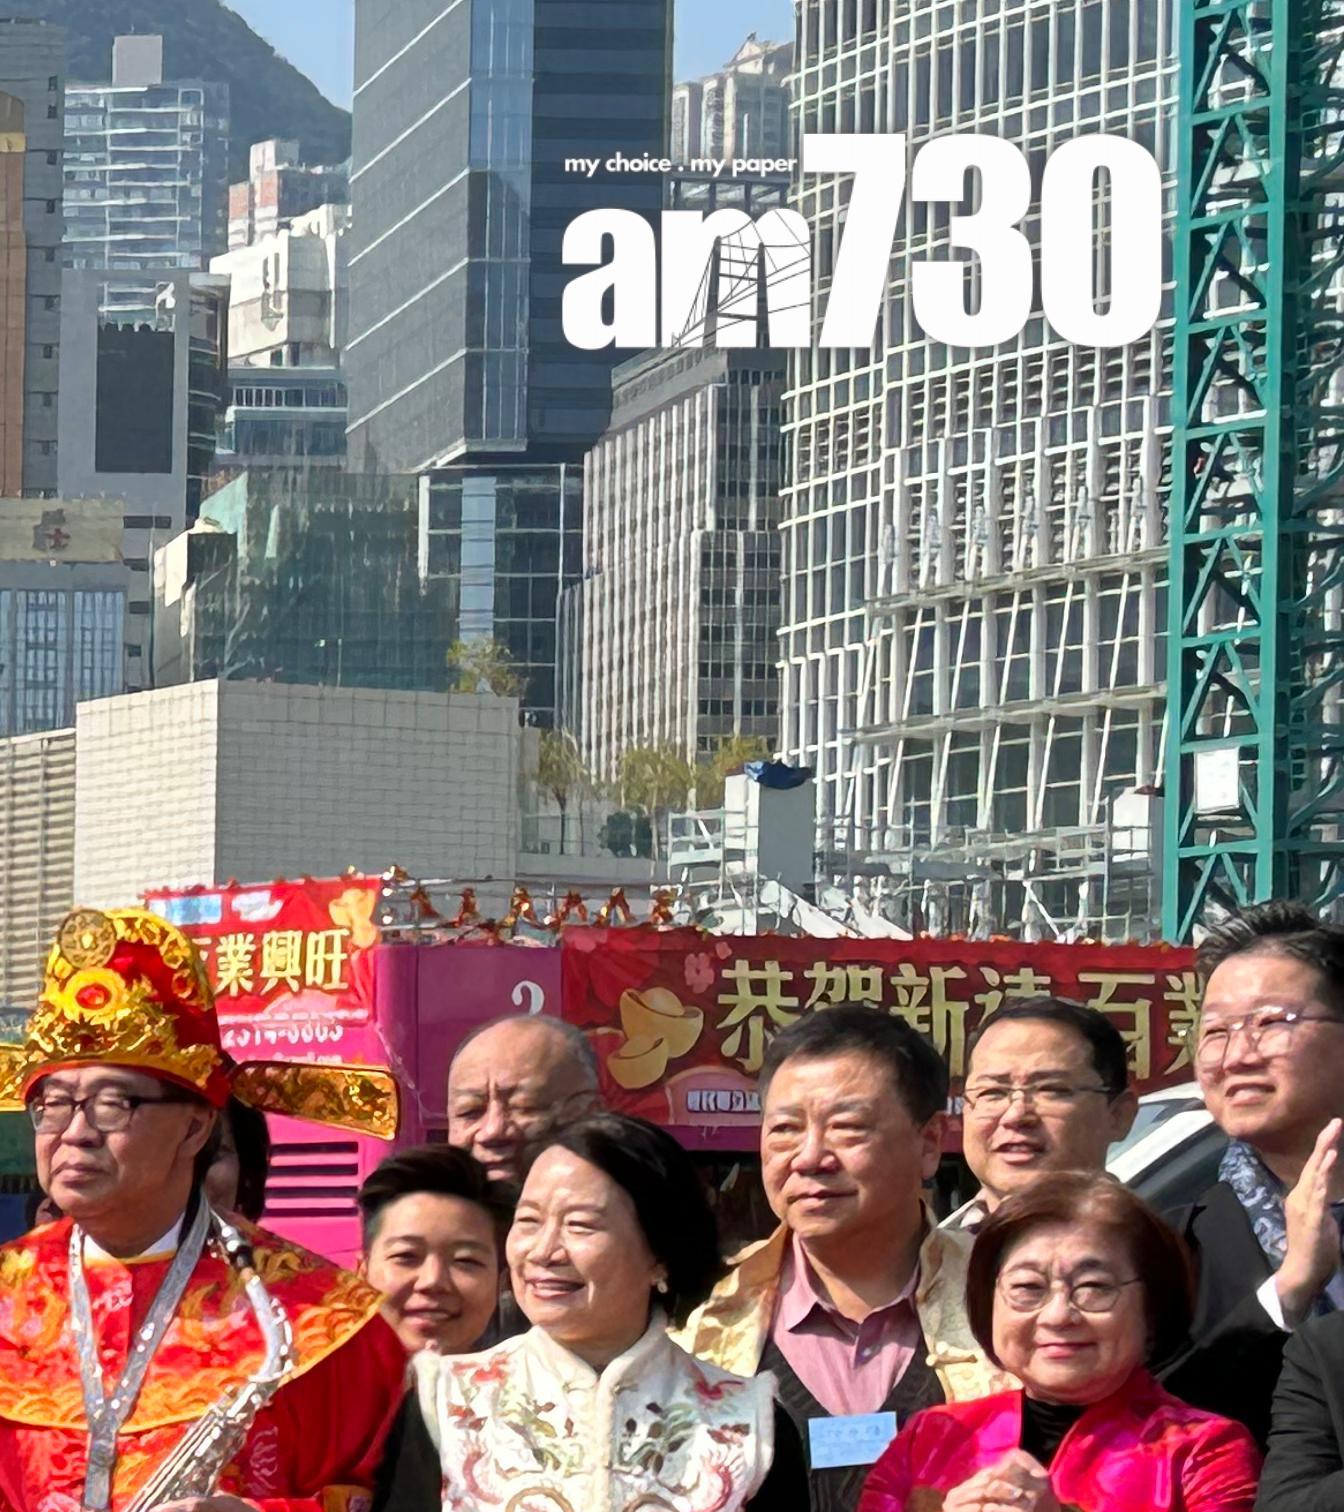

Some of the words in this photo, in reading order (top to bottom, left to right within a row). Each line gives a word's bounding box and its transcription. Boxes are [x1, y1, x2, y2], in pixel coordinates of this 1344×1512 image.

[192, 928, 350, 997] 業興旺
[716, 959, 1052, 1078] 恭新
